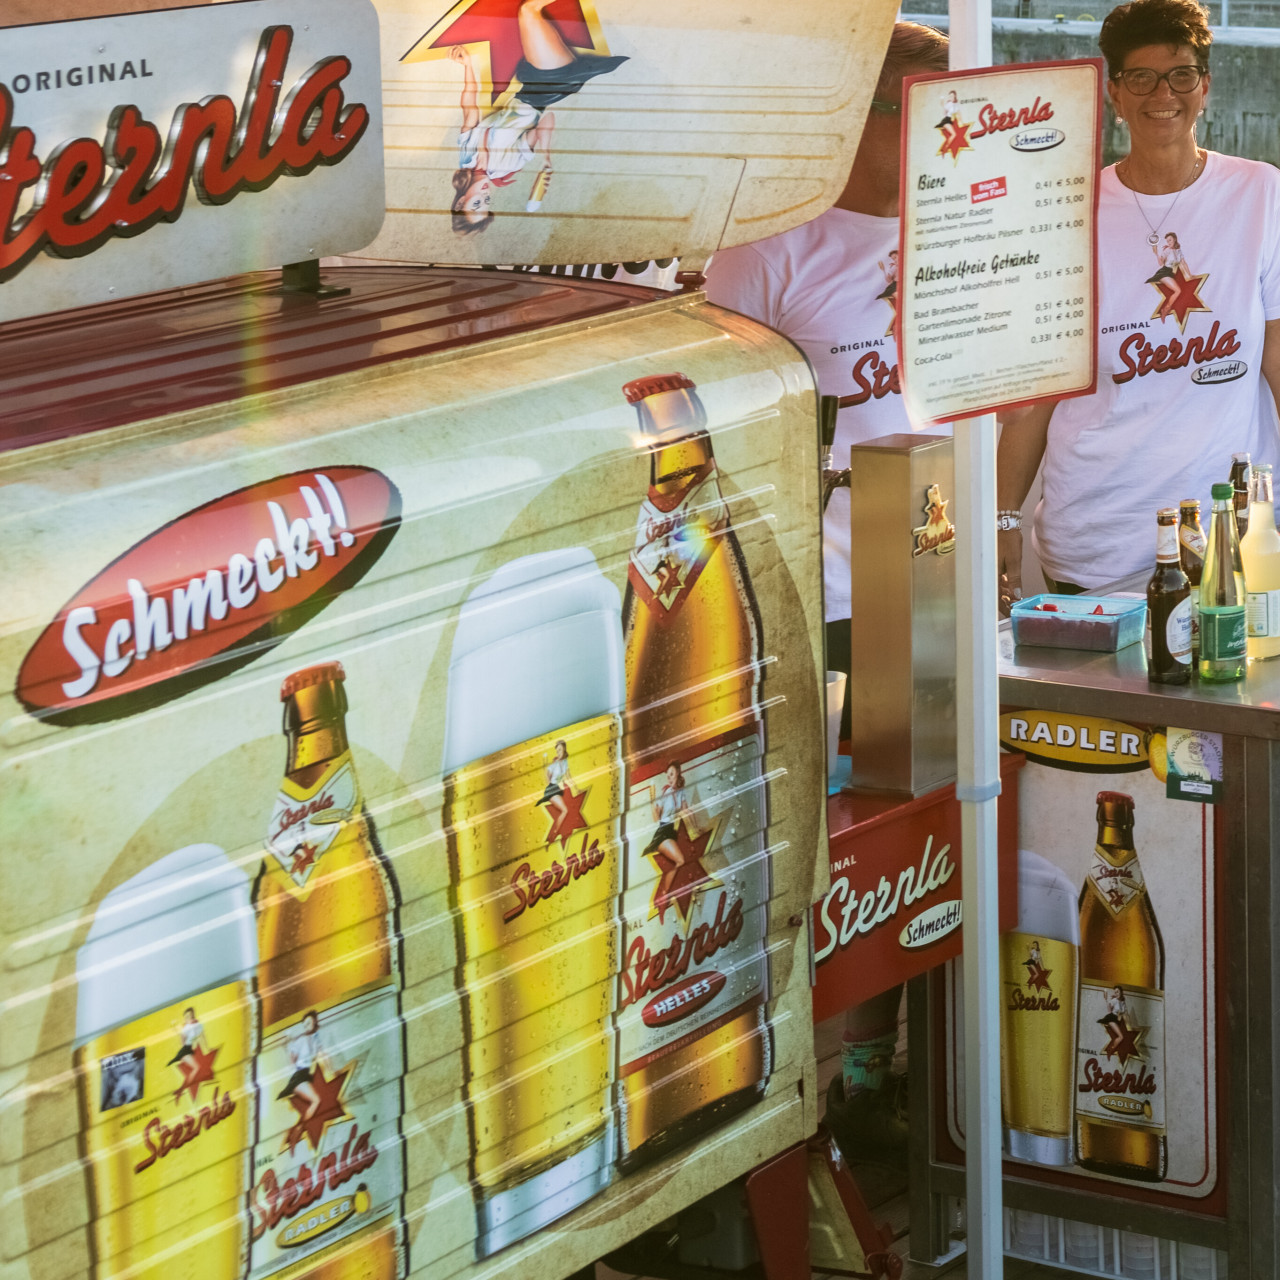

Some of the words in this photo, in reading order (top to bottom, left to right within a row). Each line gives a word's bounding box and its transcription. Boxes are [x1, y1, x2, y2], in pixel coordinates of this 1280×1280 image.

[12, 59, 154, 94] ORIGINAL
[970, 96, 1055, 140] Sternla
[0, 24, 370, 284] ternla
[1014, 131, 1058, 148] Schmeckt!
[917, 174, 946, 191] Biere
[944, 193, 968, 203] Helles
[1065, 176, 1085, 186] 5,00
[989, 187, 1006, 197] Fass
[944, 211, 966, 221] Natur
[968, 207, 994, 217] Radler
[1065, 194, 1085, 204] 5,00
[915, 236, 962, 252] Würzburger
[963, 231, 996, 244] Hofbräu
[998, 227, 1023, 238] Pilsner
[1065, 219, 1084, 228] 4,00
[914, 258, 987, 286] Alkoholfreie
[991, 249, 1040, 274] Getränke
[914, 285, 958, 300] Mönchshof
[959, 278, 1003, 293] Alkoholfrei
[1004, 275, 1020, 284] Hell
[1065, 265, 1084, 275] 5,00
[913, 310, 929, 320] Bad
[931, 302, 979, 316] Brambacher
[918, 314, 982, 332] Gartenlimonade
[984, 310, 1012, 320] Zitrone
[1056, 300, 1063, 308] €
[1065, 297, 1084, 307] 4,00
[918, 329, 975, 345] Mineralwasser
[976, 323, 1008, 335] Medium
[1056, 313, 1063, 321] €
[1065, 310, 1084, 320] 4,00
[1101, 321, 1151, 334] ORIGINAL
[830, 339, 885, 354] ORIGINAL
[914, 352, 953, 366] Coca-Cola
[1056, 332, 1063, 340] €
[1065, 328, 1084, 338] 4,00
[1112, 320, 1241, 385] Sternla
[1196, 362, 1240, 381] Schmeckt!
[60, 473, 357, 700] Schmeckt!
[1009, 718, 1141, 757] RADLER
[504, 832, 605, 925] Sternla
[830, 854, 857, 873] INAL
[814, 834, 956, 968] Sternla
[906, 901, 961, 945] Schmeckt!
[619, 890, 744, 1010] Sternla
[653, 978, 711, 1017] HELLES
[1008, 988, 1060, 1011] Sternla
[1079, 1058, 1157, 1095] Sternla
[1103, 1098, 1142, 1110] RADLER
[284, 1199, 351, 1242] RADLER
